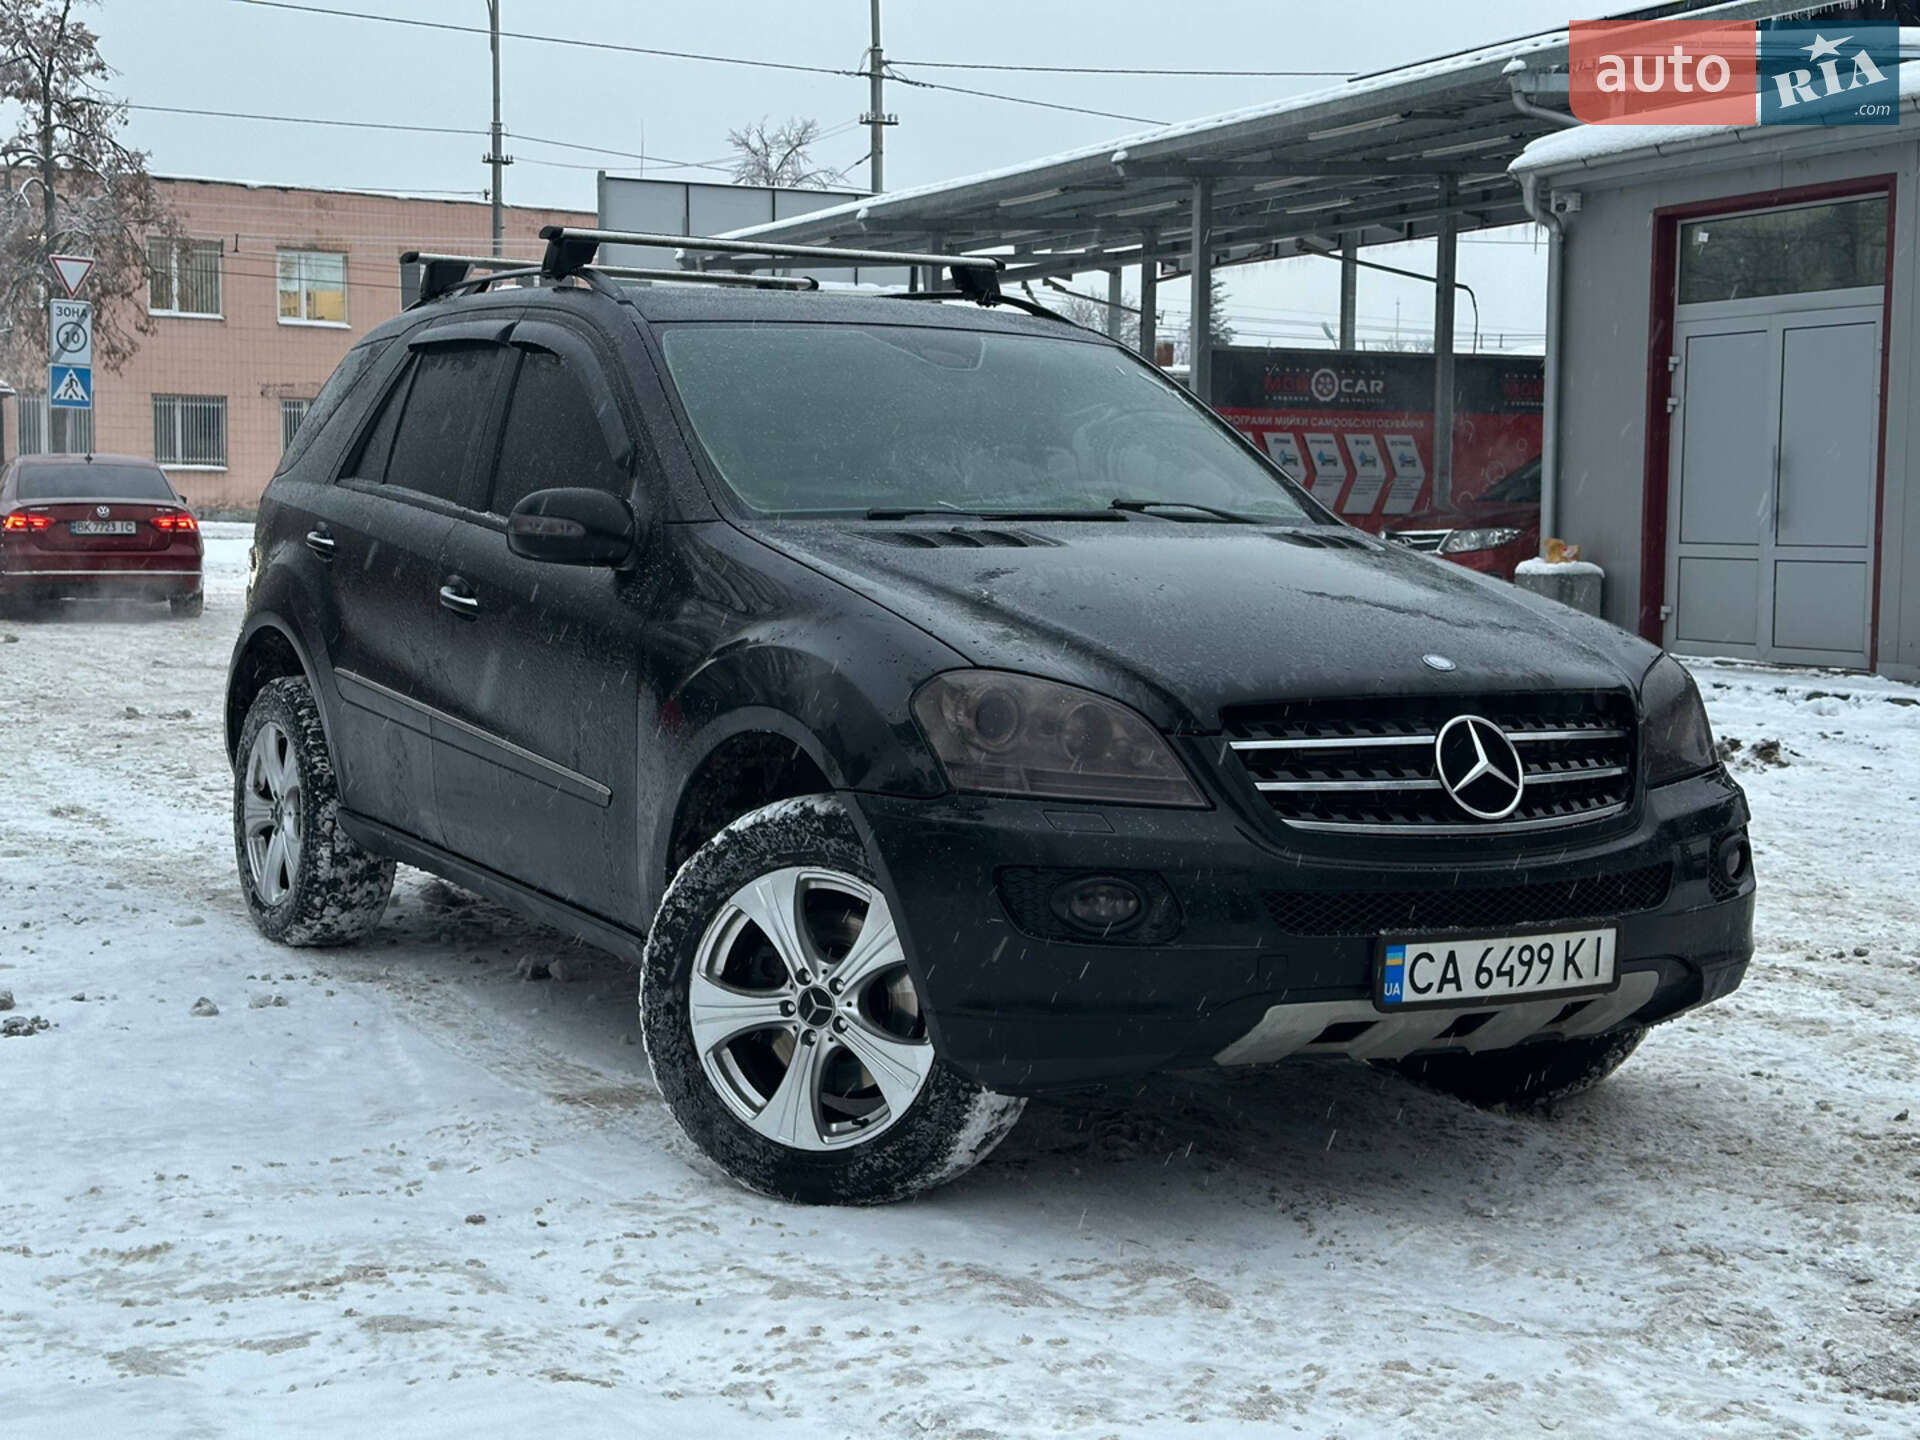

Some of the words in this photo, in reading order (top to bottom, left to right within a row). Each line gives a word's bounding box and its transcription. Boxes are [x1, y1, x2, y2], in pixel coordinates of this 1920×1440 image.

[55, 305, 88, 318] ЗОНА
[64, 330, 80, 345] 10
[1340, 379, 1385, 394] CAR
[1408, 949, 1463, 995] CA
[1474, 942, 1554, 991] 6499
[1563, 936, 1602, 982] KI
[1384, 982, 1401, 997] UA
